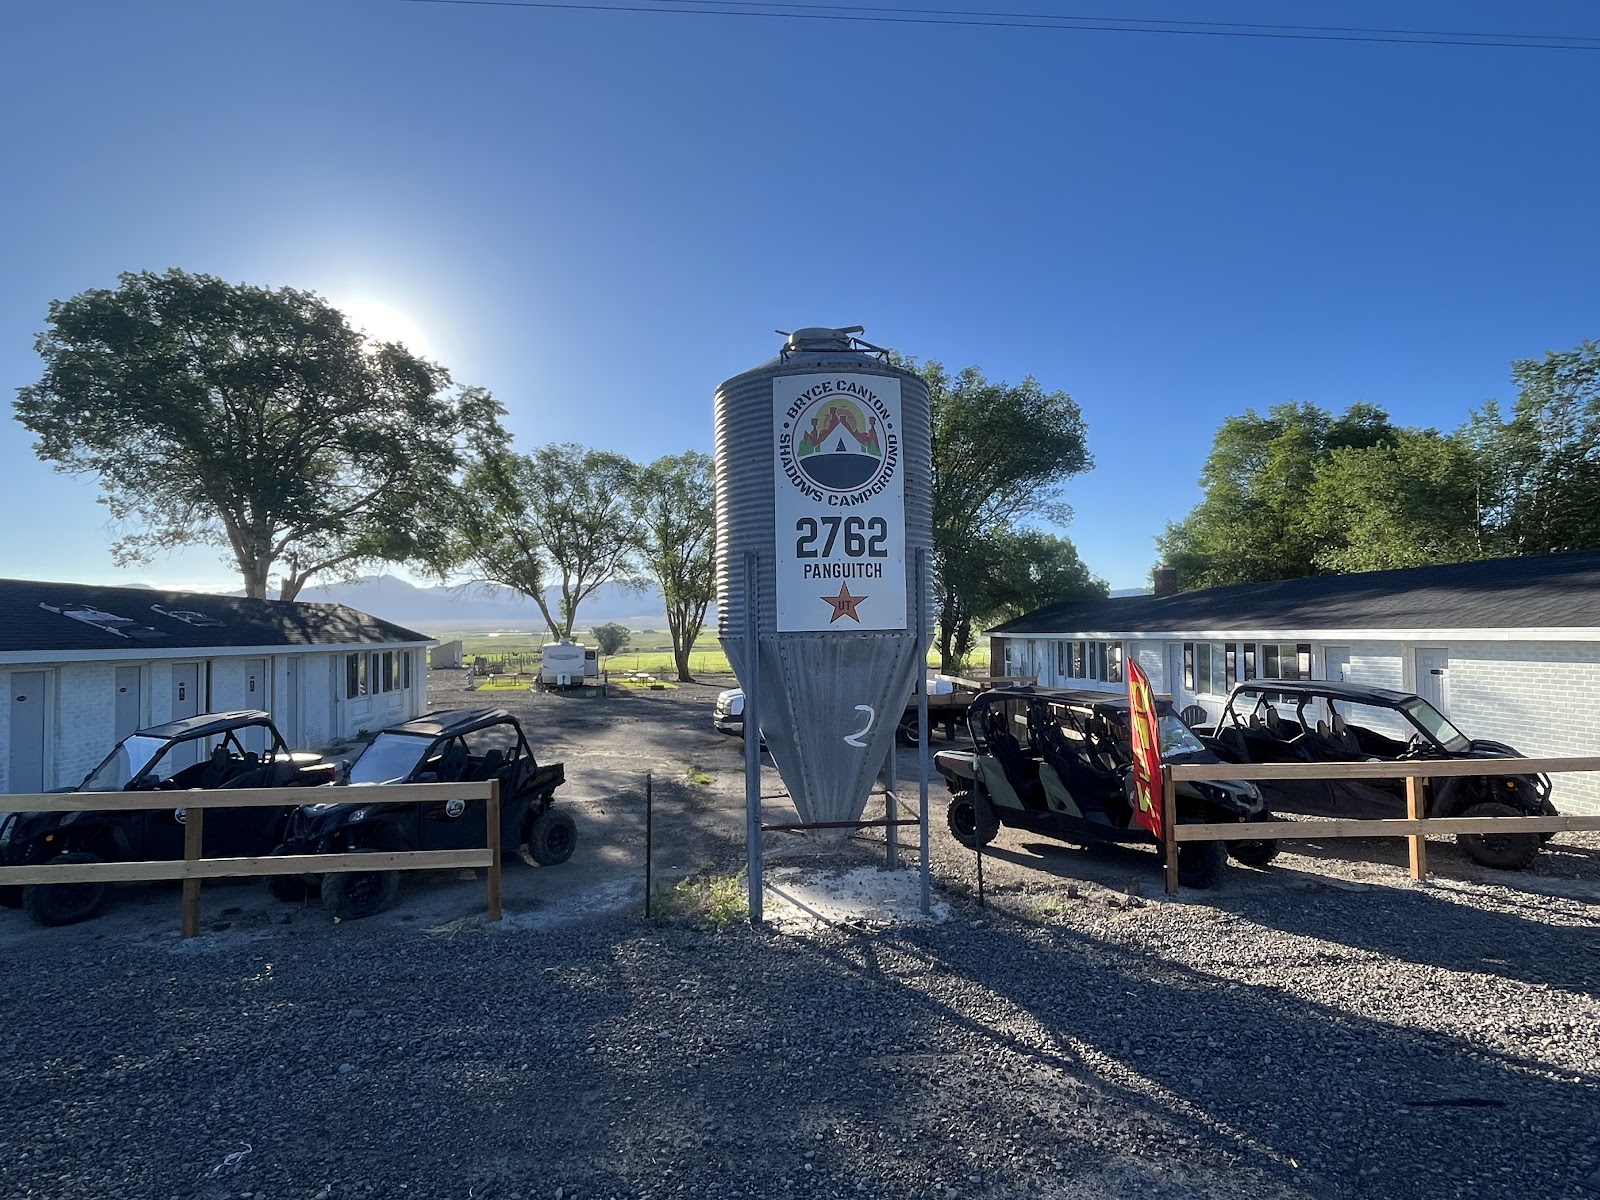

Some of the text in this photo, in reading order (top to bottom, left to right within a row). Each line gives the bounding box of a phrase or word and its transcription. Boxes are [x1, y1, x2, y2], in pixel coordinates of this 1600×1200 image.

[786, 380, 891, 420] BRYCE CANYON
[779, 432, 898, 507] SHADOWS CAMPGROUND
[796, 516, 888, 558] 2762
[803, 562, 882, 579] PANGUITCH
[838, 600, 852, 611] UT
[843, 704, 875, 747] 2
